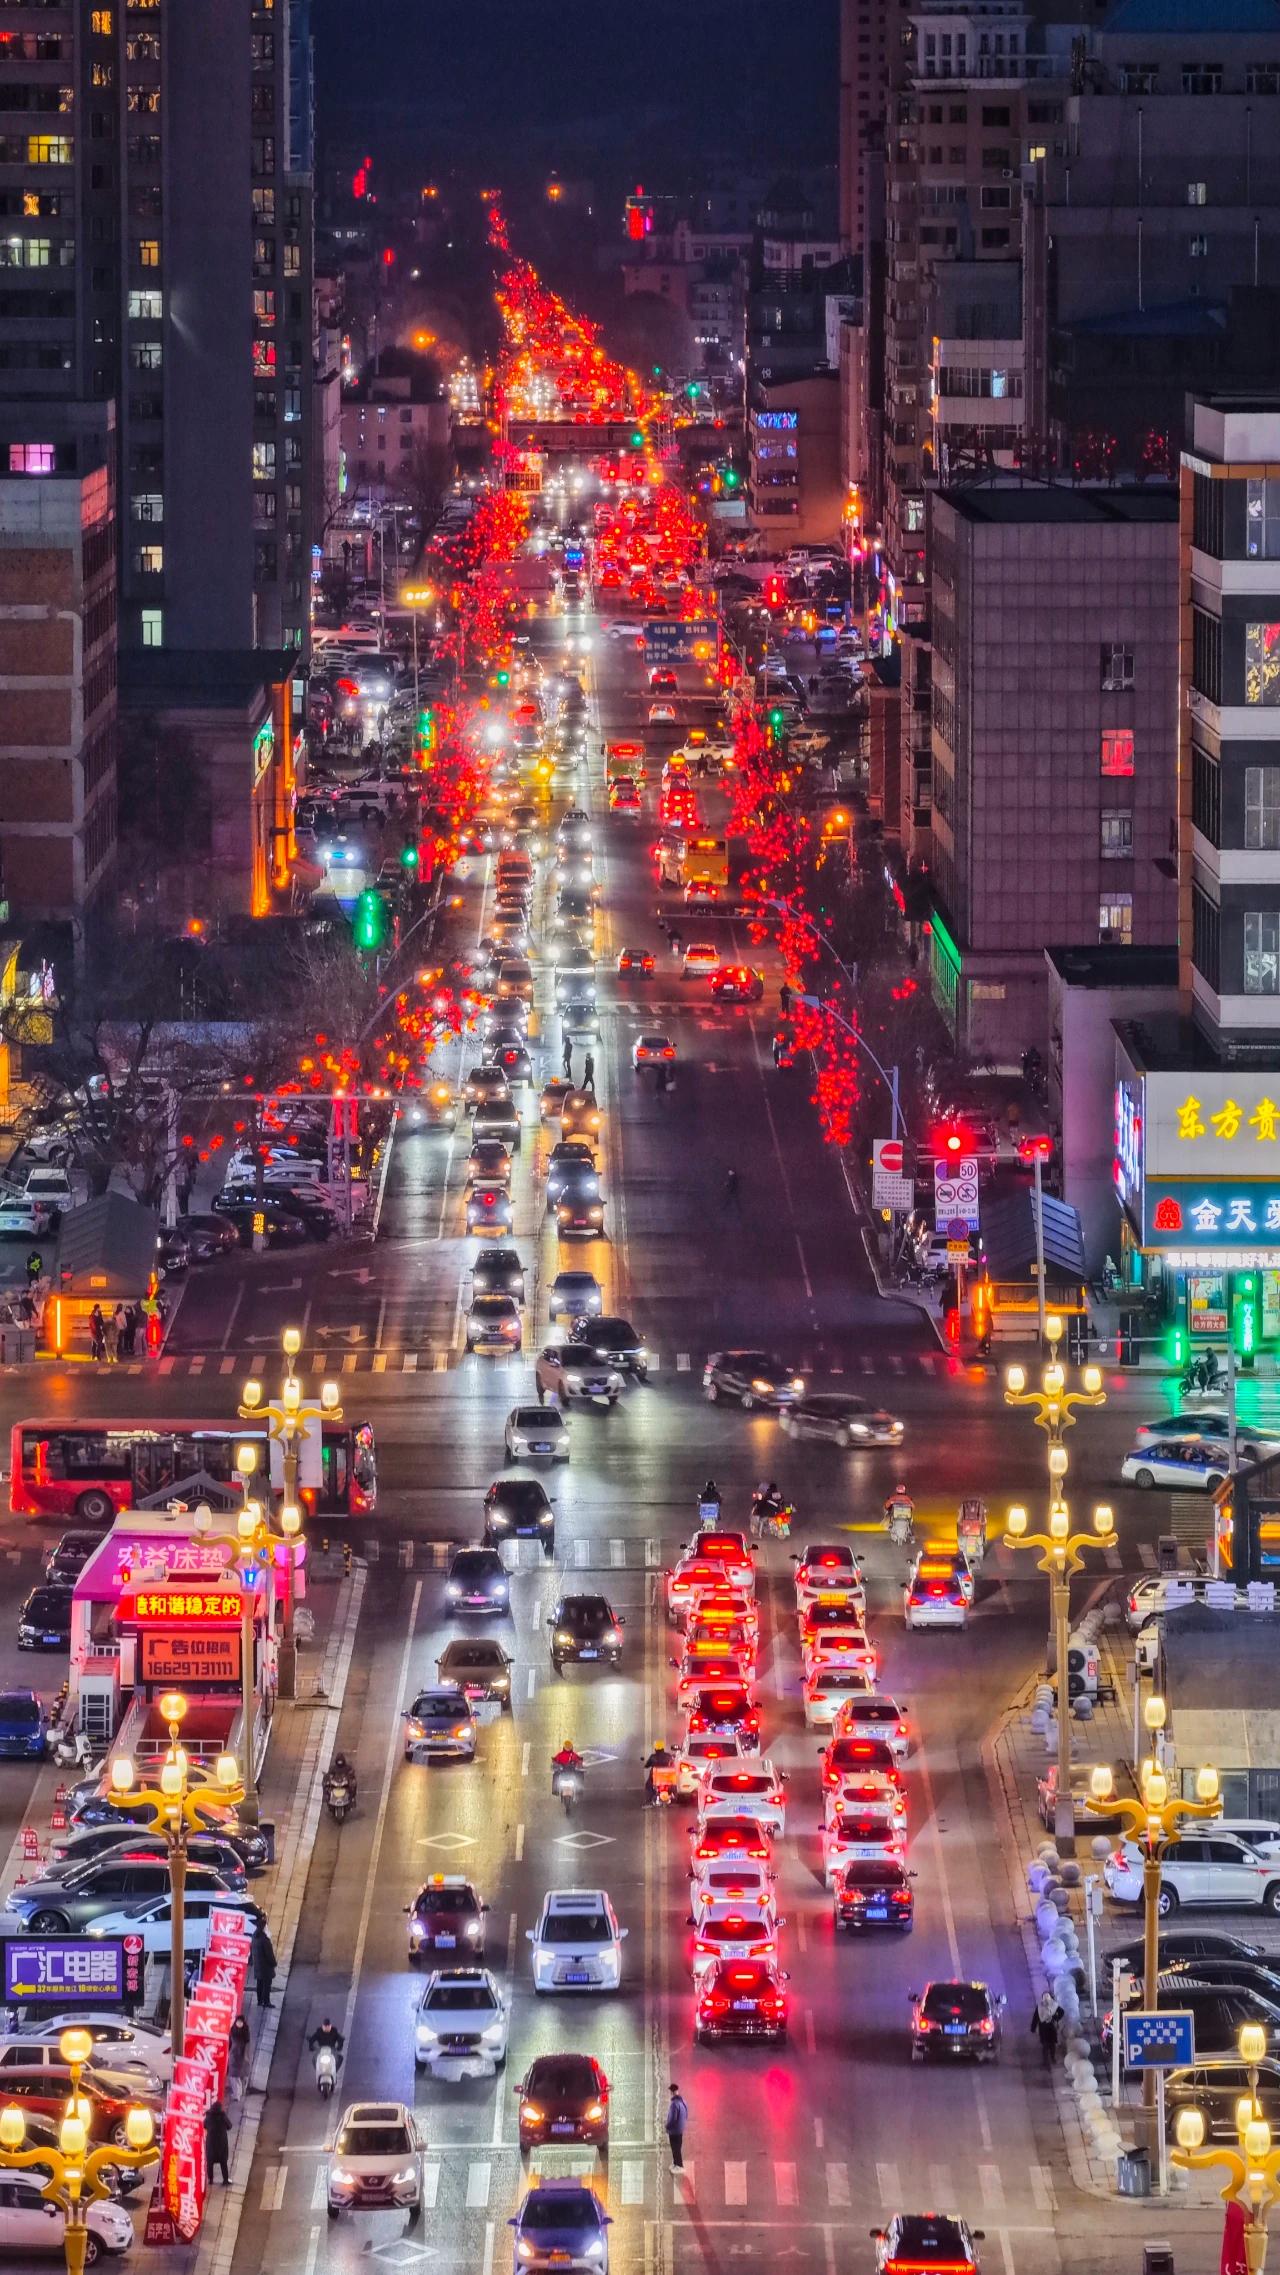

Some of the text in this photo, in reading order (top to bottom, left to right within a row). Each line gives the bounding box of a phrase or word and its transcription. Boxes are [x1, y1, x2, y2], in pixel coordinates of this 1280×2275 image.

[961, 1165, 973, 1177] 50
[147, 1660, 233, 1676] 16629731111
[11, 1950, 118, 1983] 广汇电器
[1129, 2044, 1143, 2062] P
